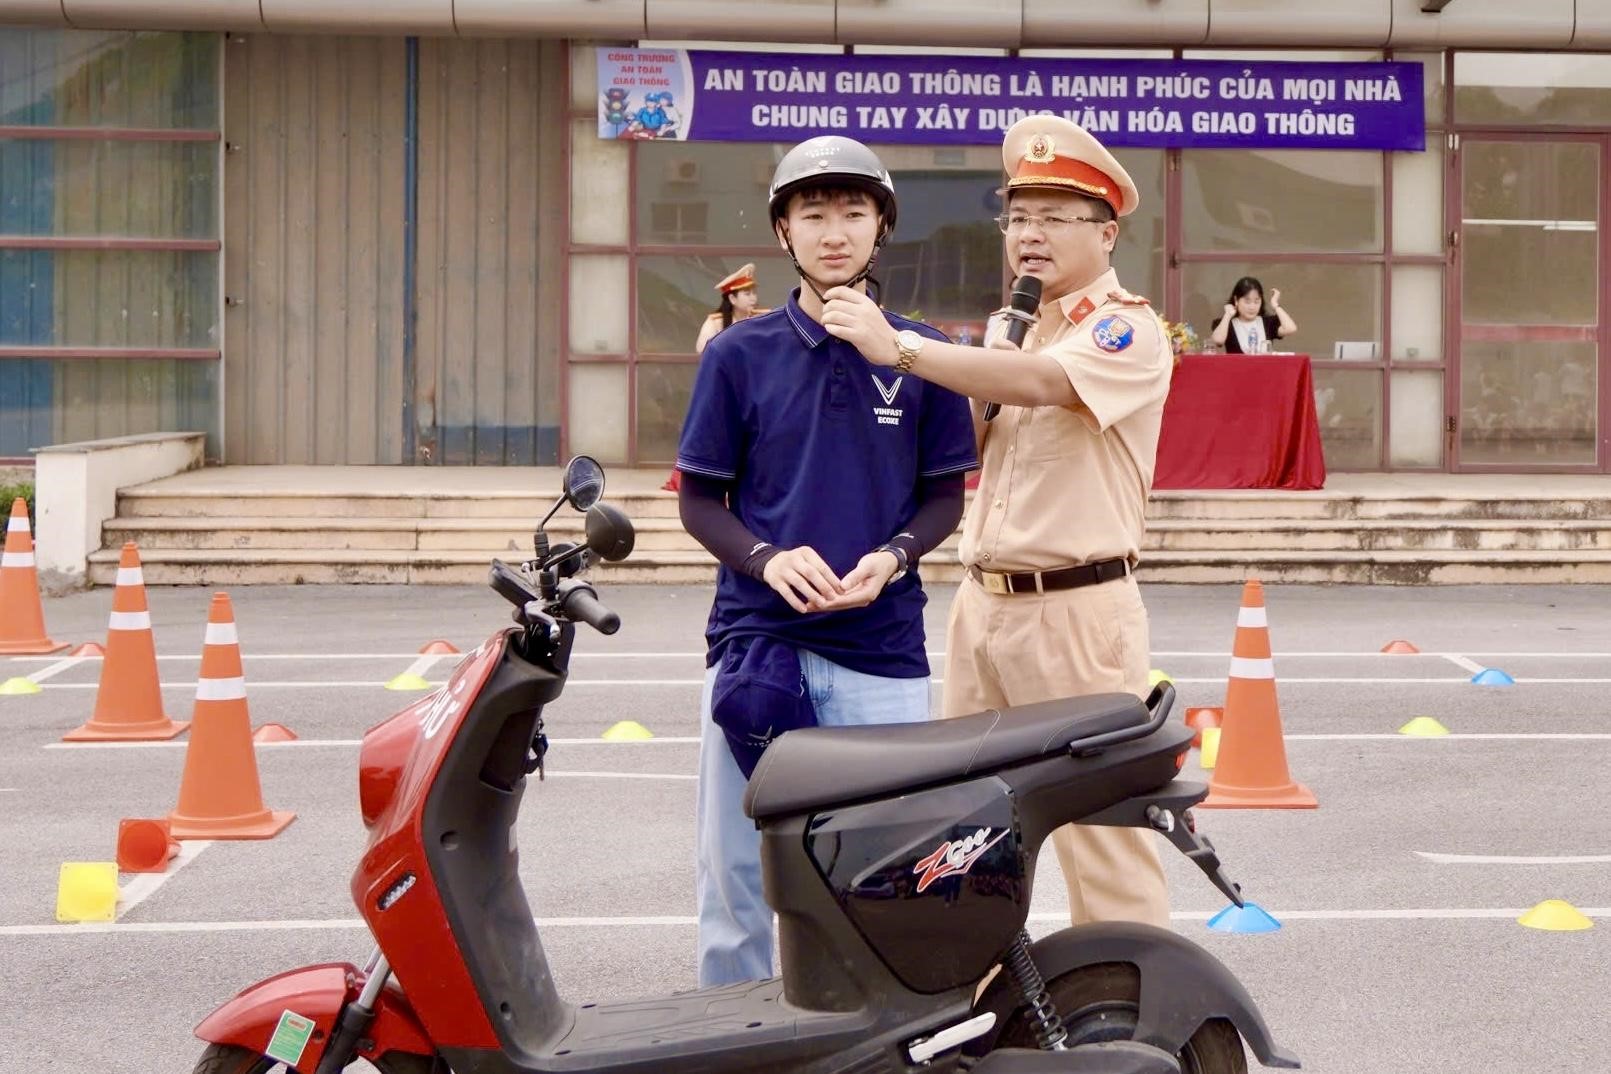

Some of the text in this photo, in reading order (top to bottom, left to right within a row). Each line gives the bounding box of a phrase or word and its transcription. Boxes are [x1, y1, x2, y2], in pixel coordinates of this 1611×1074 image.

[704, 66, 1401, 104] AN TOÀN GIAO THÔNG LÀ HẠNH PHÚC CỦA MỌI NHÀ
[752, 104, 848, 128] CHUNG
[856, 106, 907, 128] TAY
[916, 104, 970, 129] XÂY
[1063, 106, 1119, 131] VĂN
[1128, 106, 1183, 132] HÓA
[1192, 111, 1256, 134] GIAO
[1264, 109, 1355, 135] THÔNG
[873, 407, 903, 416] VINFAST
